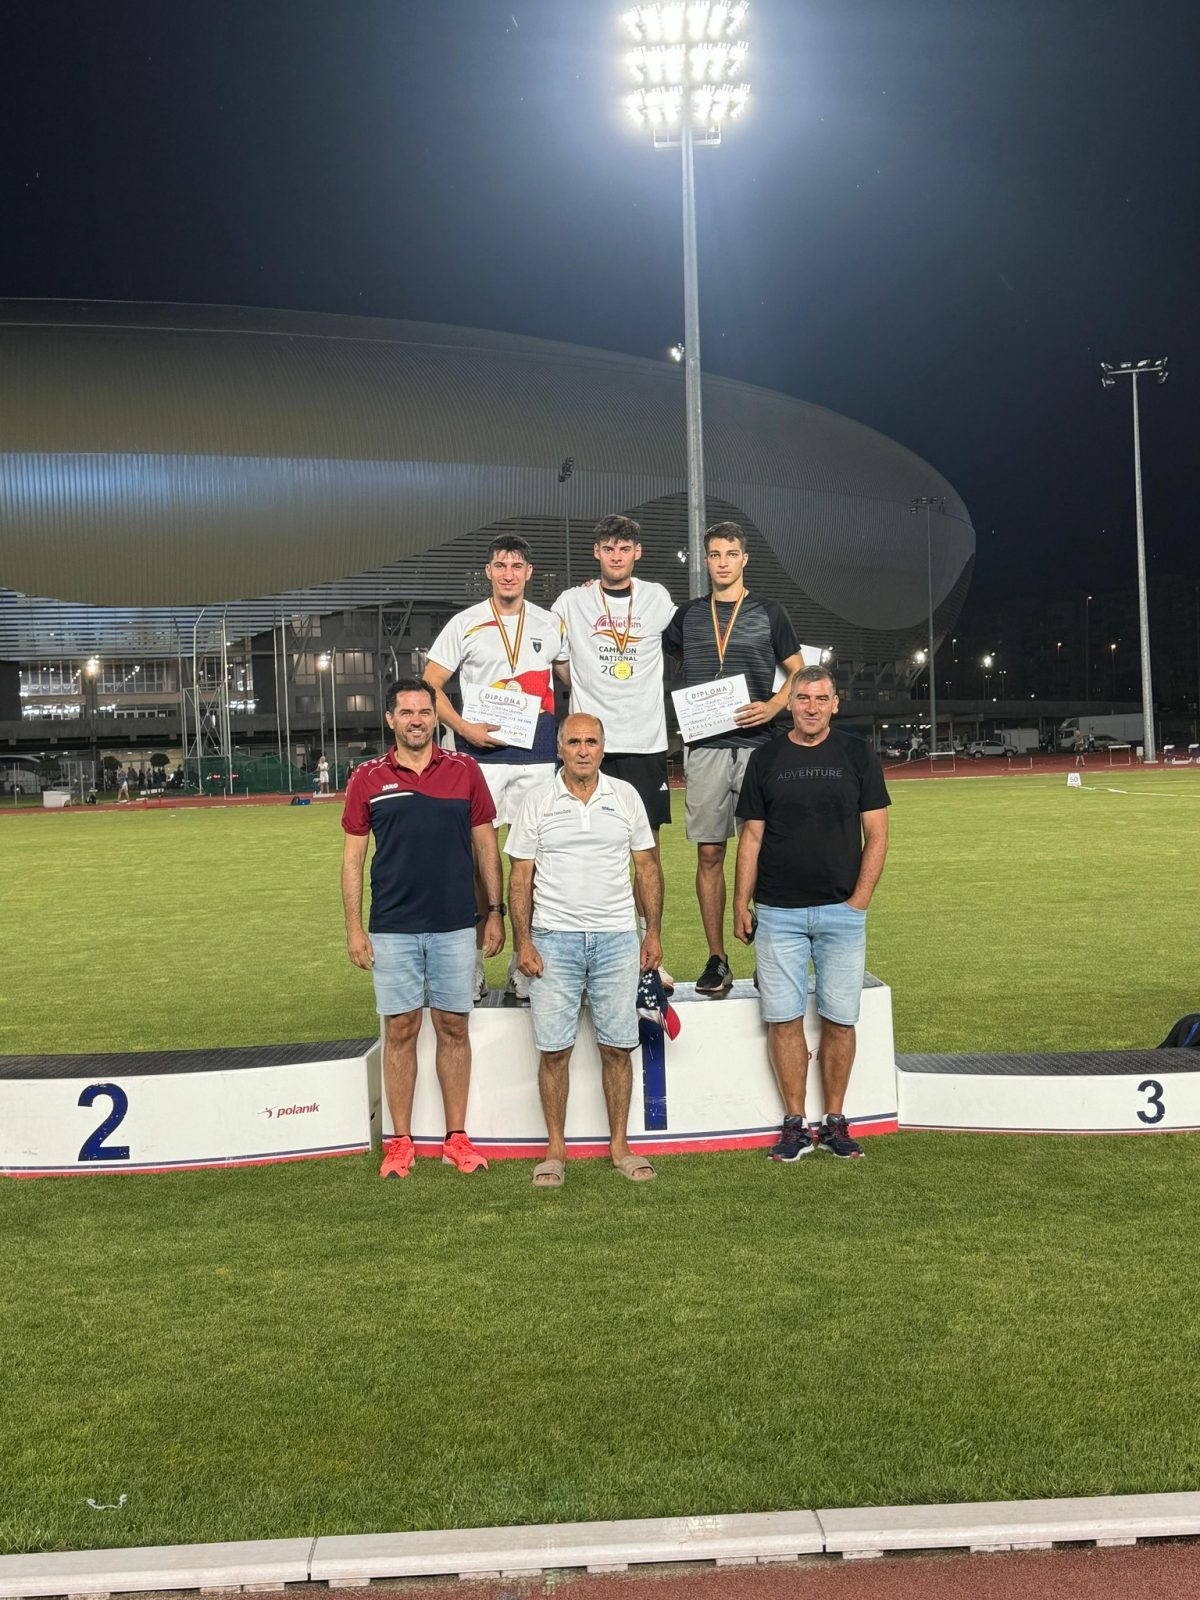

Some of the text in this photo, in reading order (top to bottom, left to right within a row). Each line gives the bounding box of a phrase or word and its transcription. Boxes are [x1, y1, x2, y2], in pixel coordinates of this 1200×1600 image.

[607, 619, 641, 629] aletsm
[598, 646, 637, 654] CAMON
[599, 654, 638, 662] NATIONAL
[600, 664, 634, 677] 20
[484, 692, 521, 706] DIPLOMA
[691, 685, 728, 700] DIPLOMA
[777, 768, 843, 781] ADVENTURE
[382, 782, 399, 791] JAKO
[1136, 1079, 1166, 1124] 3
[276, 1102, 320, 1119] polanik
[77, 1082, 130, 1162] 2
